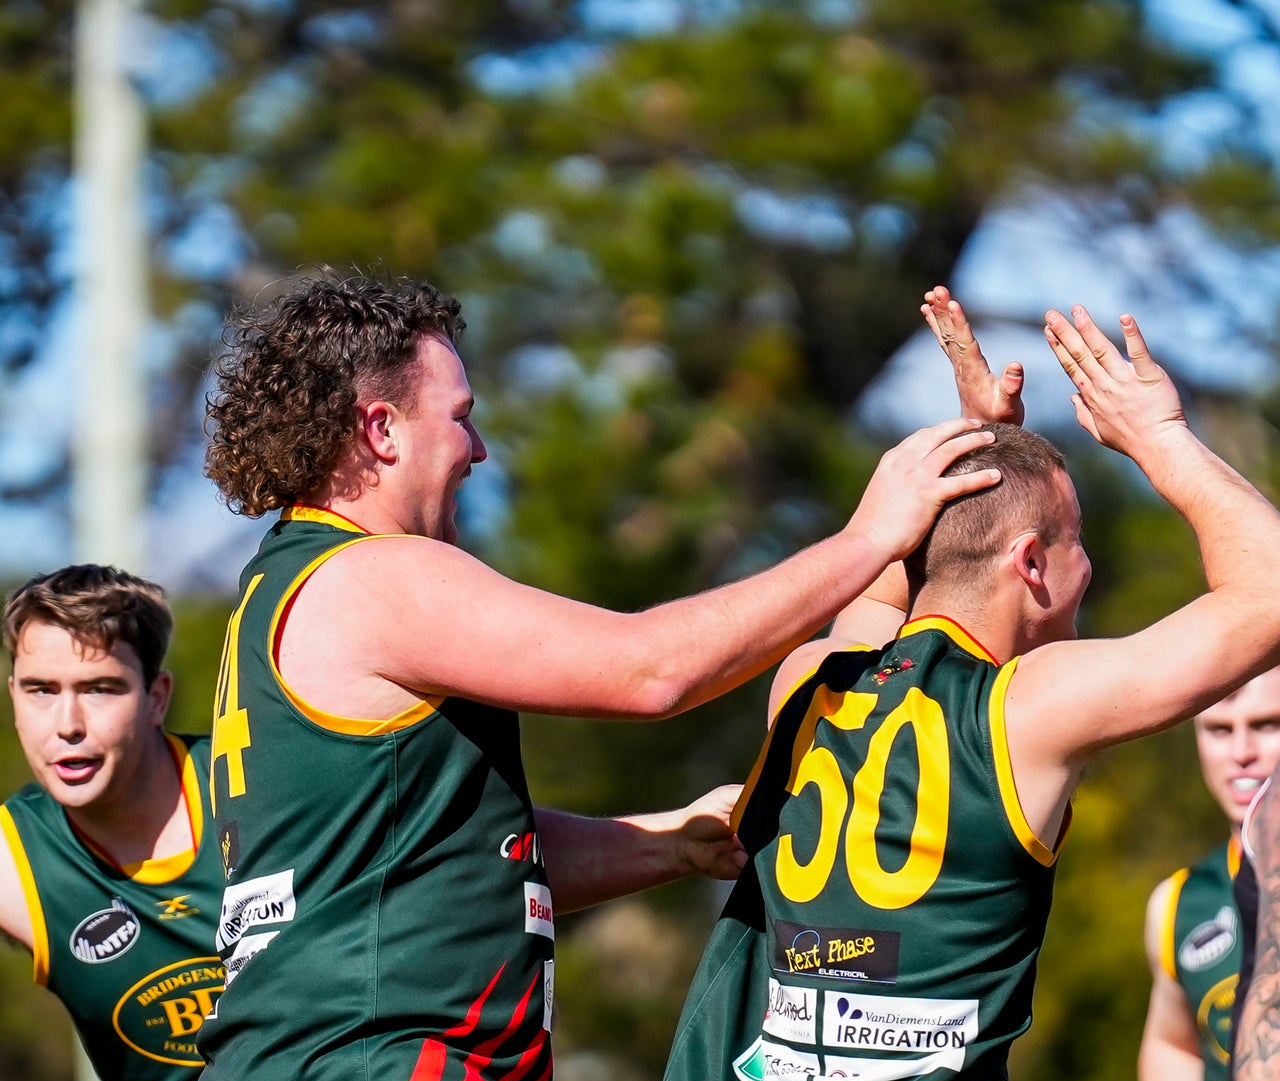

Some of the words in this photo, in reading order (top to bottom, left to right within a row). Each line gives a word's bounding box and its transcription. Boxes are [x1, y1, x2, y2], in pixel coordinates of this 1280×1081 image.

[775, 684, 950, 909] 50
[95, 920, 137, 957] NTFA
[785, 944, 821, 973] Next
[827, 936, 876, 963] Phase
[818, 967, 869, 979] ELECTRICAL
[837, 1024, 966, 1049] IRRIGATION
